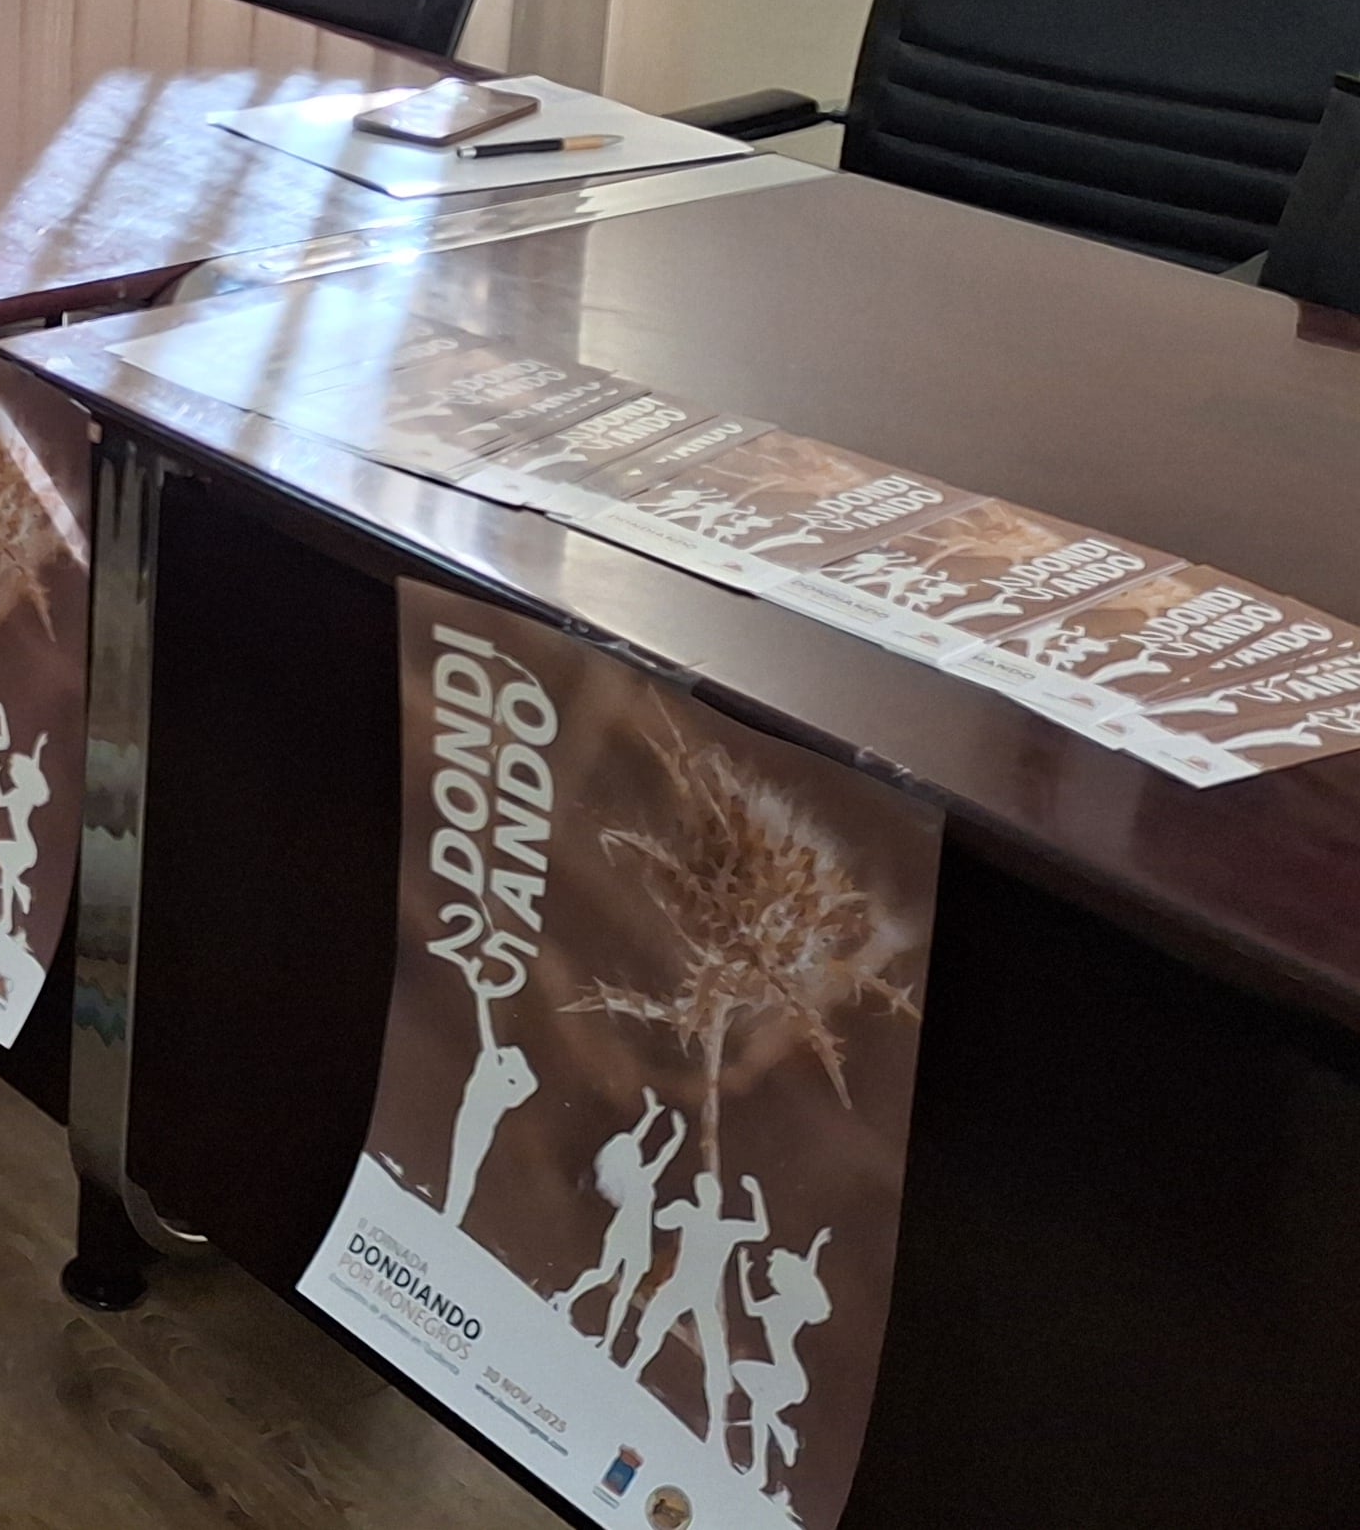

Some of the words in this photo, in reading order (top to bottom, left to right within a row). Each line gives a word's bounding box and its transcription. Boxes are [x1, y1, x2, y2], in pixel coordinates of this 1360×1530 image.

[609, 409, 687, 445] ANDO
[816, 474, 921, 514] DONDI
[851, 490, 943, 527] ANDO
[1009, 538, 1120, 580] DONDI
[1050, 555, 1146, 596] ANDO
[1145, 587, 1255, 635] DONDI
[1190, 605, 1283, 651] ANDO
[430, 624, 495, 901] DONDI
[493, 678, 558, 931] ANDO
[368, 1227, 429, 1275] JORNADA
[338, 1252, 373, 1287] POR
[372, 1282, 473, 1361] MONEGROS
[348, 1233, 482, 1340] DONDIANDO
